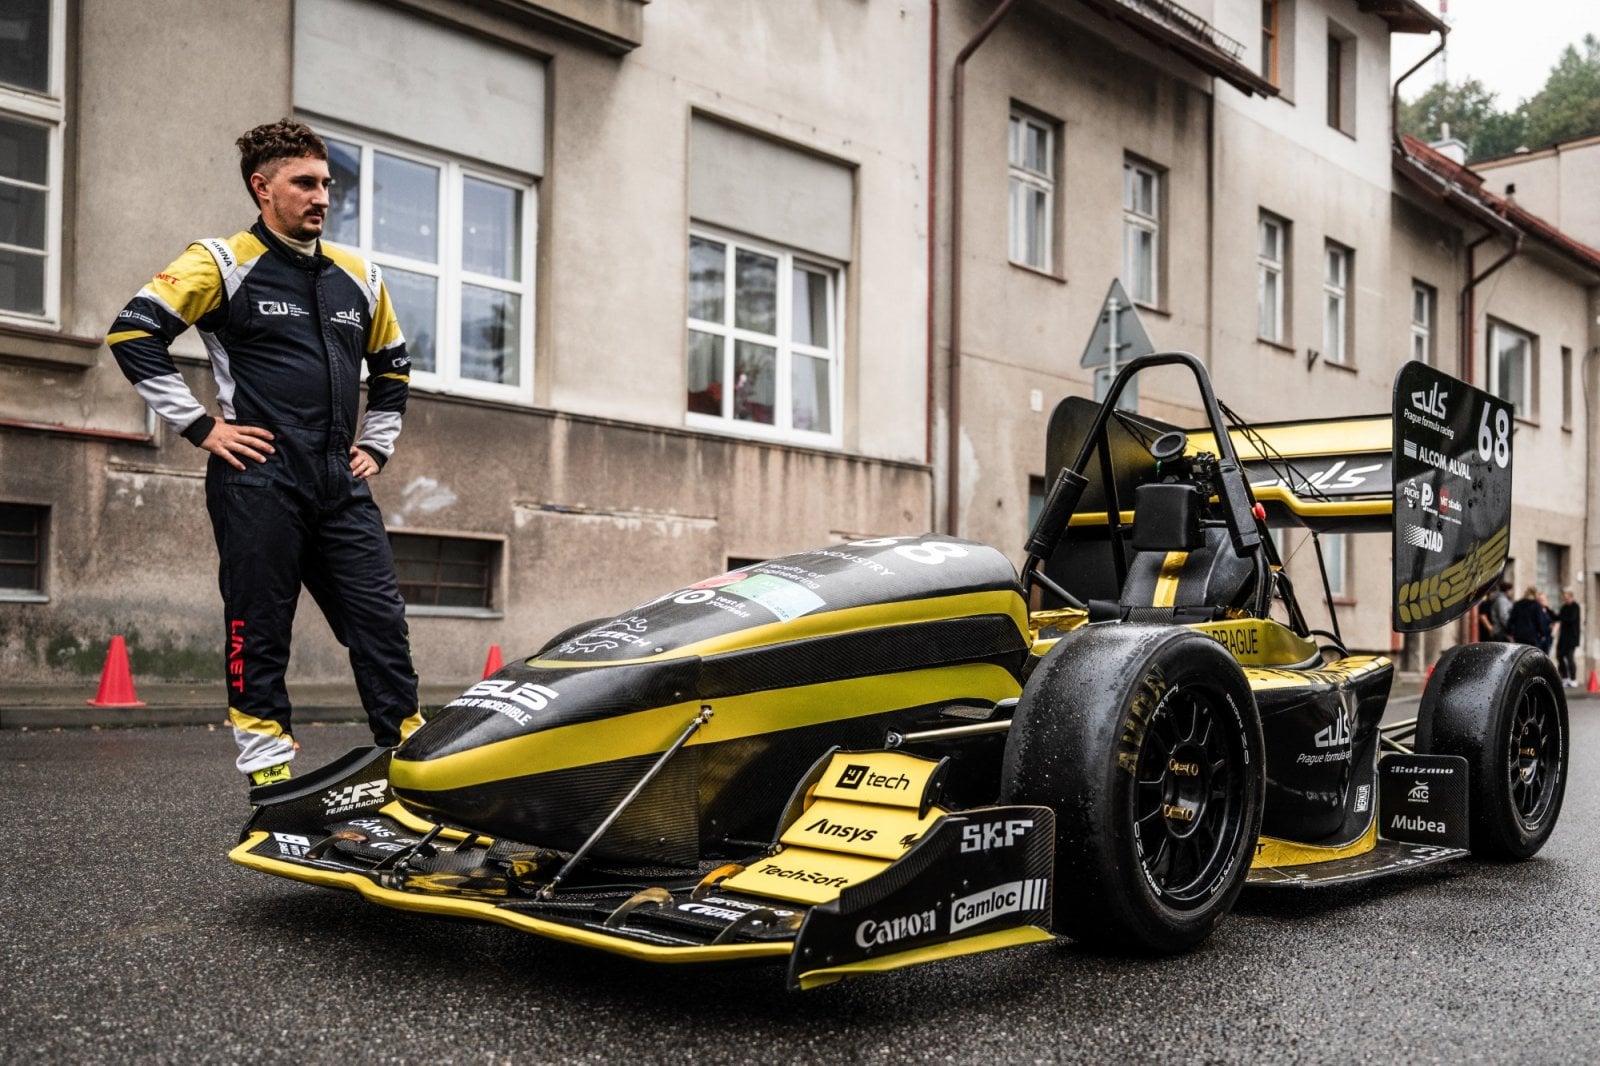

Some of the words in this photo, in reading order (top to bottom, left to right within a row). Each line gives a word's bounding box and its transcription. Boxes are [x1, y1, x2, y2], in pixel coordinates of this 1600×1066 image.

[1404, 408, 1422, 425] Prague
[1421, 415, 1440, 433] formula
[1439, 425, 1455, 440] racing
[1478, 401, 1509, 469] 68
[1419, 446, 1447, 471] ALCOM
[1448, 459, 1471, 480] ALVAL
[1403, 487, 1420, 500] FUCHS
[809, 572, 826, 580] of
[706, 599, 751, 618] yourself
[715, 595, 735, 608] test
[734, 600, 747, 610] it
[229, 619, 246, 694] LINET
[478, 699, 533, 727] INCREDIBLE
[1296, 753, 1324, 766] Prague
[1390, 766, 1454, 774] Bolzano
[866, 771, 910, 791] tech
[1412, 790, 1430, 799] NC
[325, 804, 355, 816] FEJFAR
[355, 796, 385, 810] RACING
[805, 818, 878, 843] Ansys
[1391, 814, 1446, 834] Mubea
[960, 819, 1034, 853] SKF
[1142, 860, 1162, 897] RACING
[953, 891, 1017, 925] Camloc
[855, 909, 937, 949] Canon
